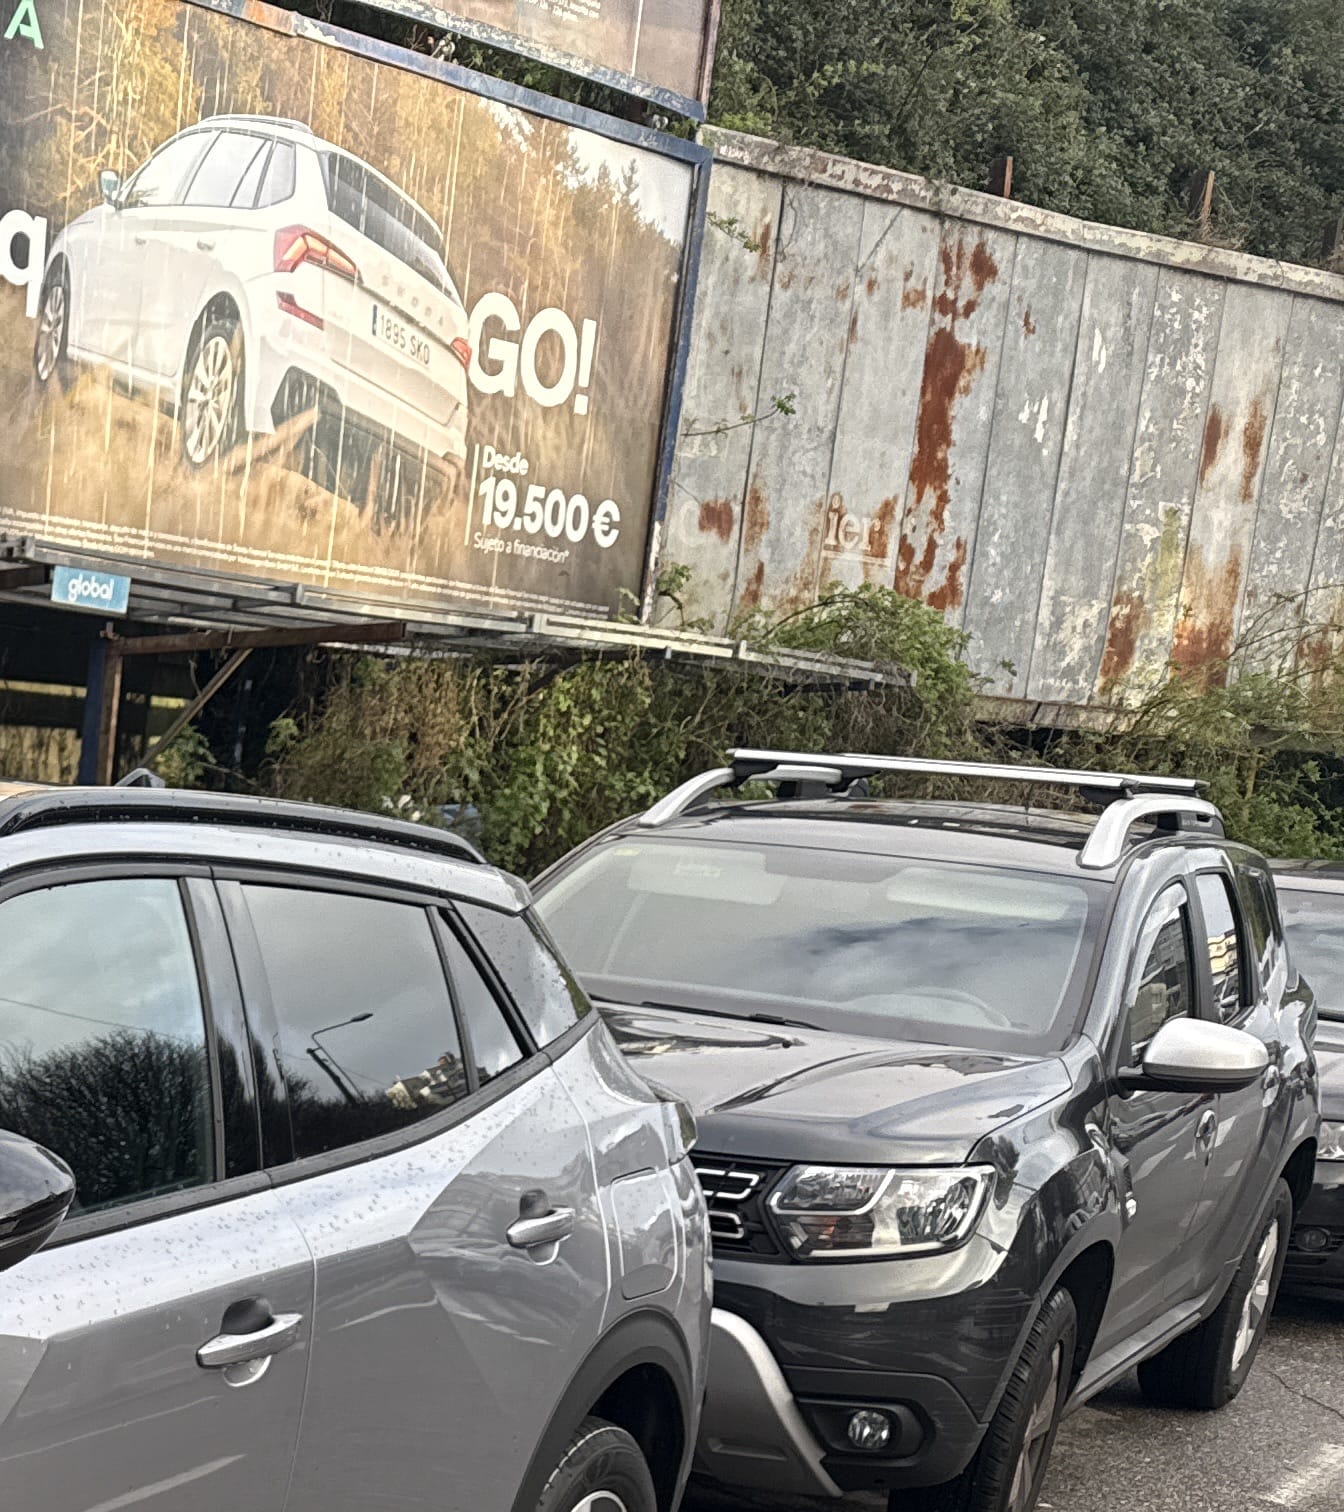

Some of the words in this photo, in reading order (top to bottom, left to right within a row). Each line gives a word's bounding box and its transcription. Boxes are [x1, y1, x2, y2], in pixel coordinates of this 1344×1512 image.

[469, 291, 597, 416] GO!
[482, 444, 529, 476] Desde
[68, 573, 114, 601] global
